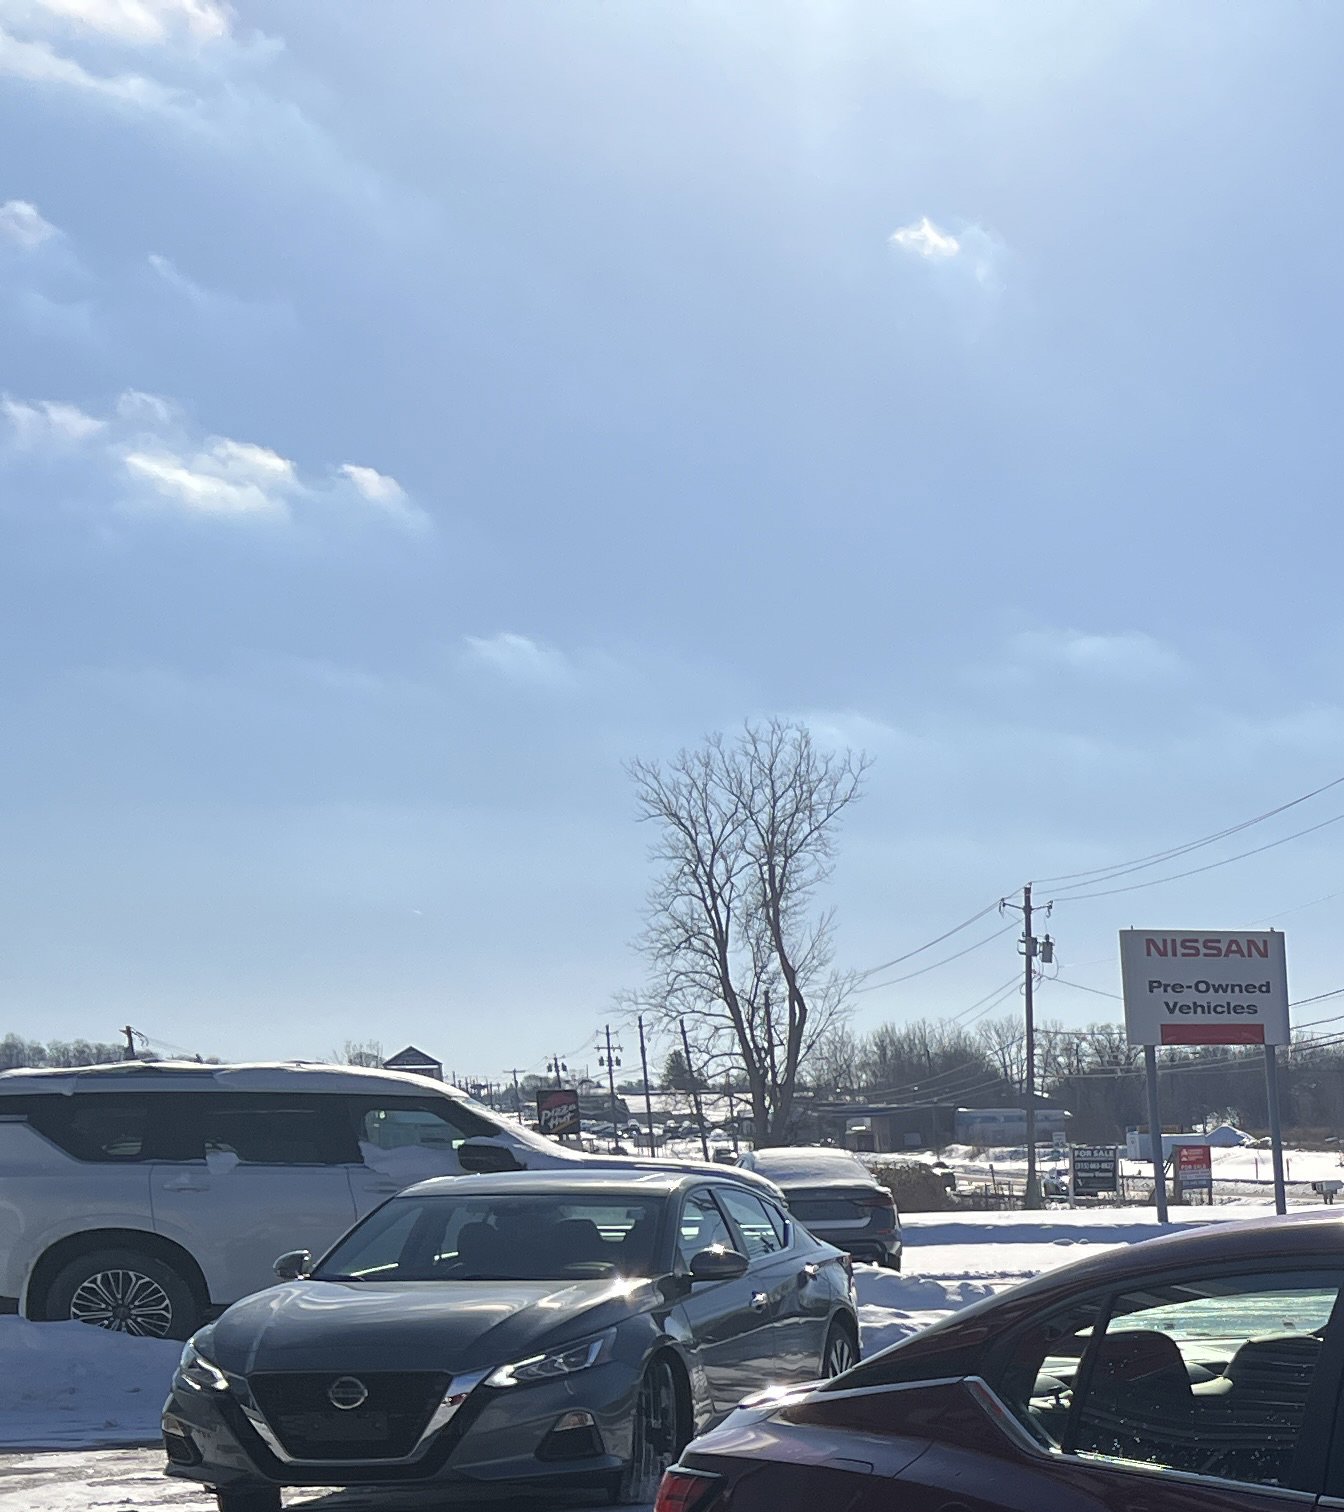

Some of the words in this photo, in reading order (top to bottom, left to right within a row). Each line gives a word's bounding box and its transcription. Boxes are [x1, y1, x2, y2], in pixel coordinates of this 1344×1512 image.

[1145, 938, 1269, 959] NISSAN
[1148, 980, 1271, 994] Pre-Owned
[1163, 1001, 1259, 1015] Vehicles
[541, 1104, 576, 1126] Pizza
[548, 1112, 575, 1130] Hut
